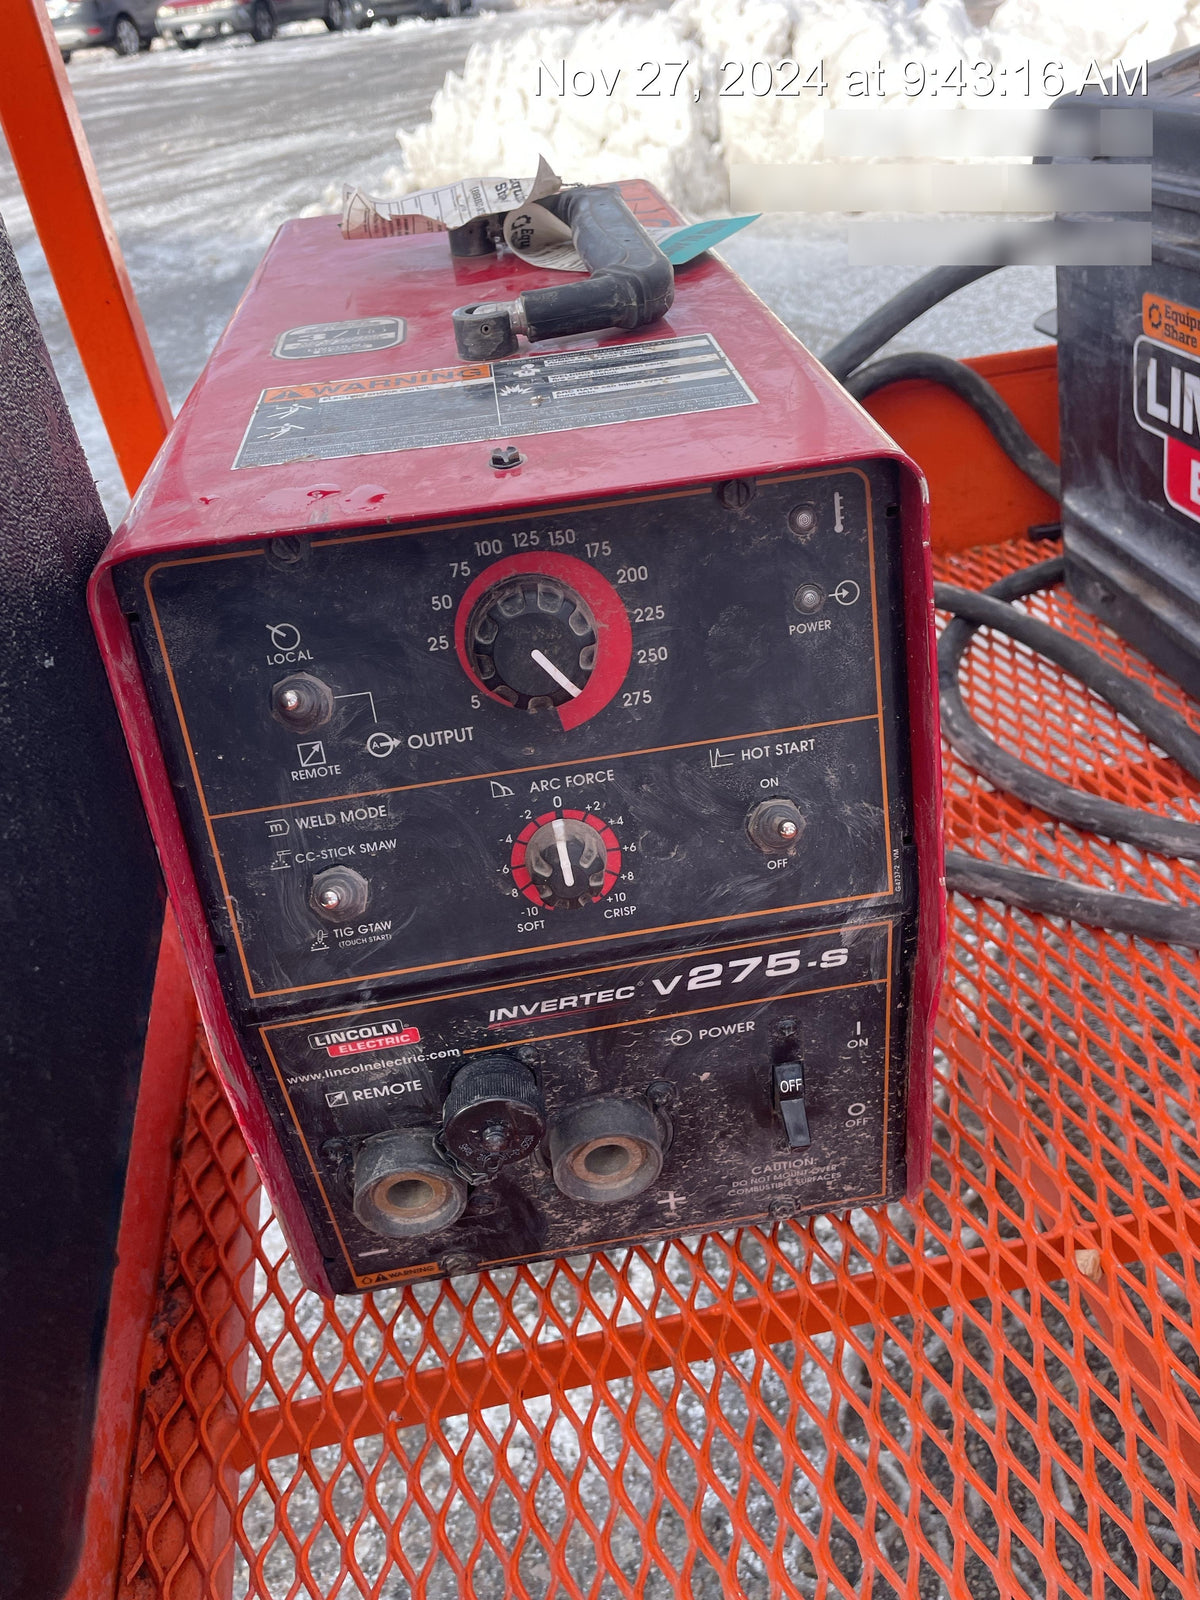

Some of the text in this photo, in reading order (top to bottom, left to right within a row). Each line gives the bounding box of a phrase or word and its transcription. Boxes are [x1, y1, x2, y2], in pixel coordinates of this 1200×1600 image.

[1164, 303, 1200, 333] Equip
[1164, 323, 1198, 348] Share
[311, 367, 482, 396] WARNING
[511, 530, 540, 548] 125
[548, 529, 576, 546] 150
[474, 538, 503, 557] 100
[585, 541, 612, 558] 175
[449, 561, 471, 578] 75
[616, 565, 648, 584] 200
[431, 594, 453, 611] 50
[634, 605, 665, 623] 225
[789, 619, 832, 636] POWER
[427, 635, 449, 652] 25
[266, 649, 314, 666] LOCAL
[637, 646, 668, 665] 250
[470, 696, 481, 709] 5
[622, 690, 652, 707] 275
[407, 726, 474, 750] OUTPUT
[741, 738, 816, 761] HOT START
[290, 764, 342, 782] REMOTE
[529, 769, 615, 793] ARC FORCE
[759, 777, 779, 789] ON
[552, 795, 562, 808] 0
[295, 813, 336, 830] WELD
[340, 804, 388, 823] MODE
[295, 838, 397, 864] CC-STICK SMAW
[767, 858, 788, 870] OFF
[603, 905, 637, 919] CRISP
[333, 920, 392, 939] TIG GTAW
[517, 919, 546, 933] SOFT
[338, 933, 393, 949] (TOUCH START)
[313, 1022, 398, 1047] LINCOLN
[699, 1020, 756, 1040] POWER
[339, 1033, 411, 1054] ELECTRIC
[847, 1037, 869, 1049] ON
[286, 1048, 460, 1085] www.lincolnelectric.com
[352, 1079, 423, 1101] REMOTE
[780, 1078, 802, 1094] OFF
[845, 1117, 870, 1128] OFF
[751, 1157, 817, 1175] CAUTION:
[727, 1172, 842, 1197] COMBUSTIBLE SURFACES
[732, 1164, 837, 1188] DO NOT MOUNT OVER
[388, 1266, 435, 1278] WARNING
